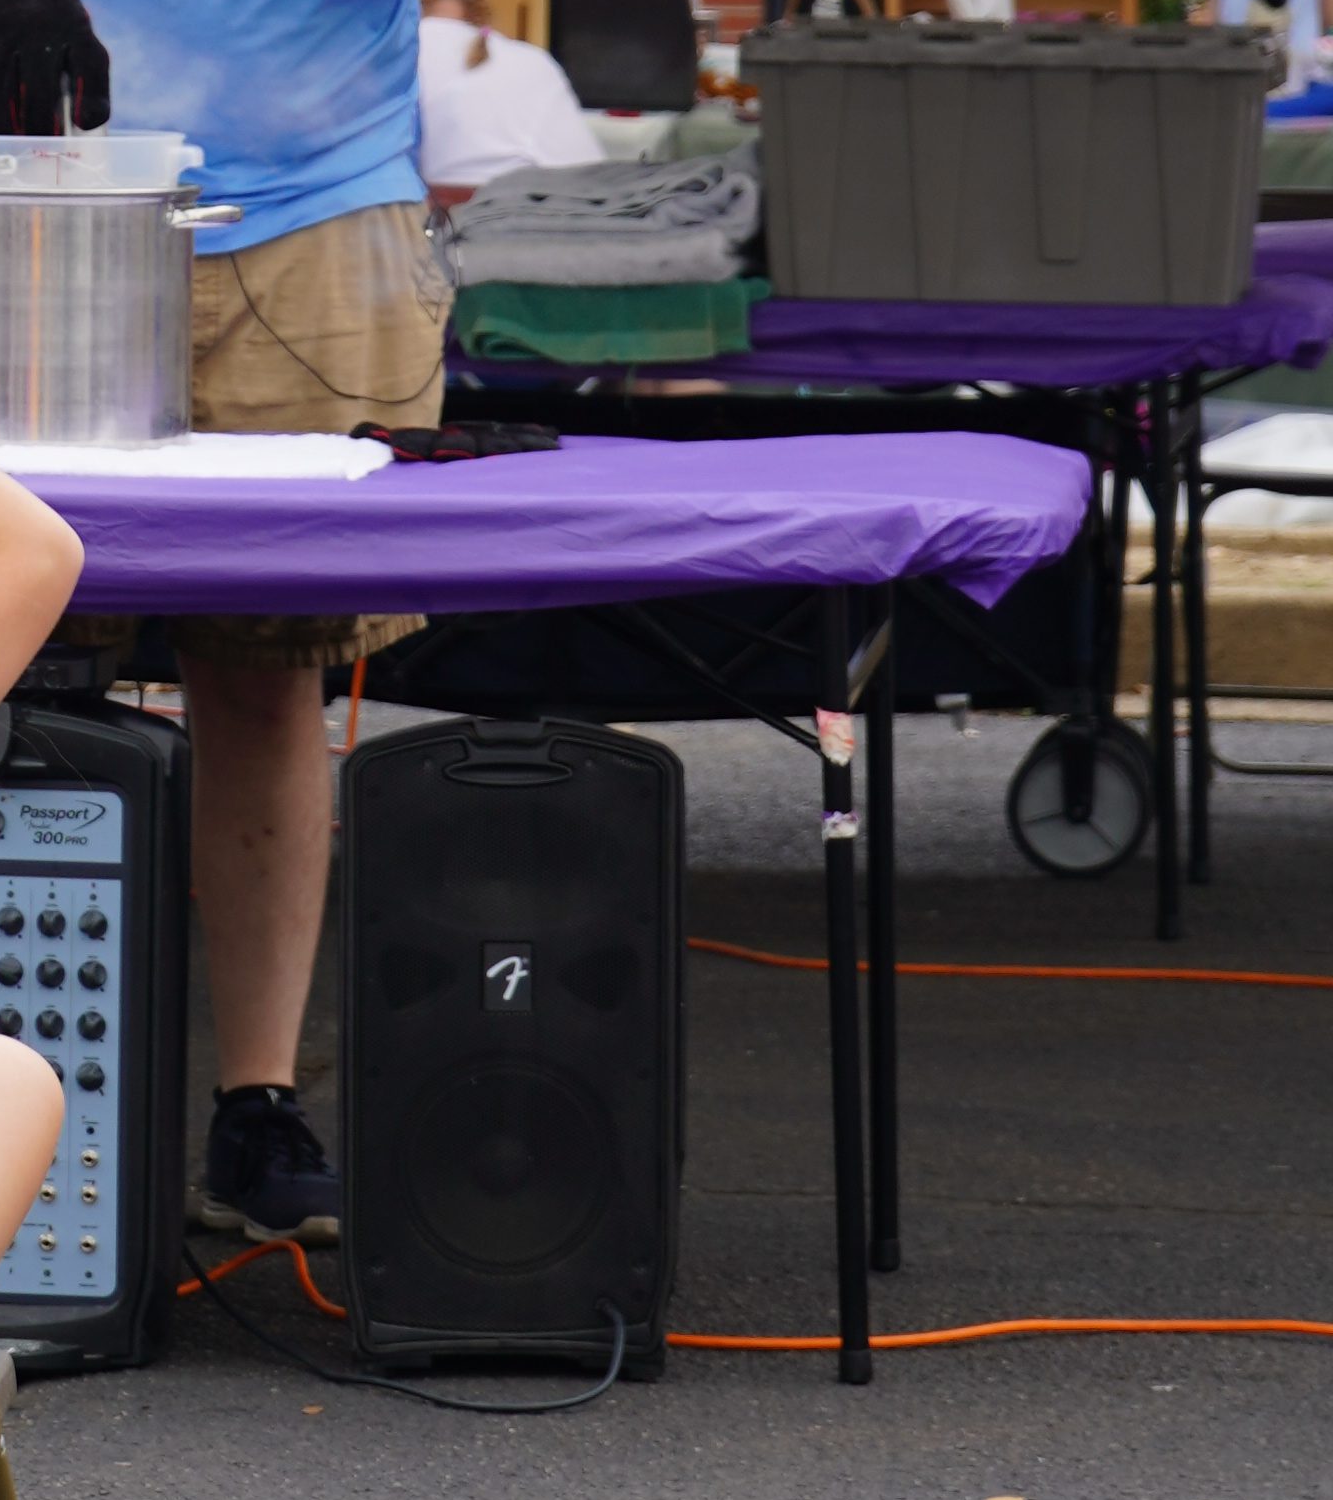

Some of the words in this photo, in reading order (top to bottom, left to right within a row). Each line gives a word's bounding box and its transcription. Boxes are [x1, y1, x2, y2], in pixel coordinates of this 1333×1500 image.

[20, 804, 90, 822] Passport
[33, 831, 63, 845] 300
[64, 836, 88, 846] PRO
